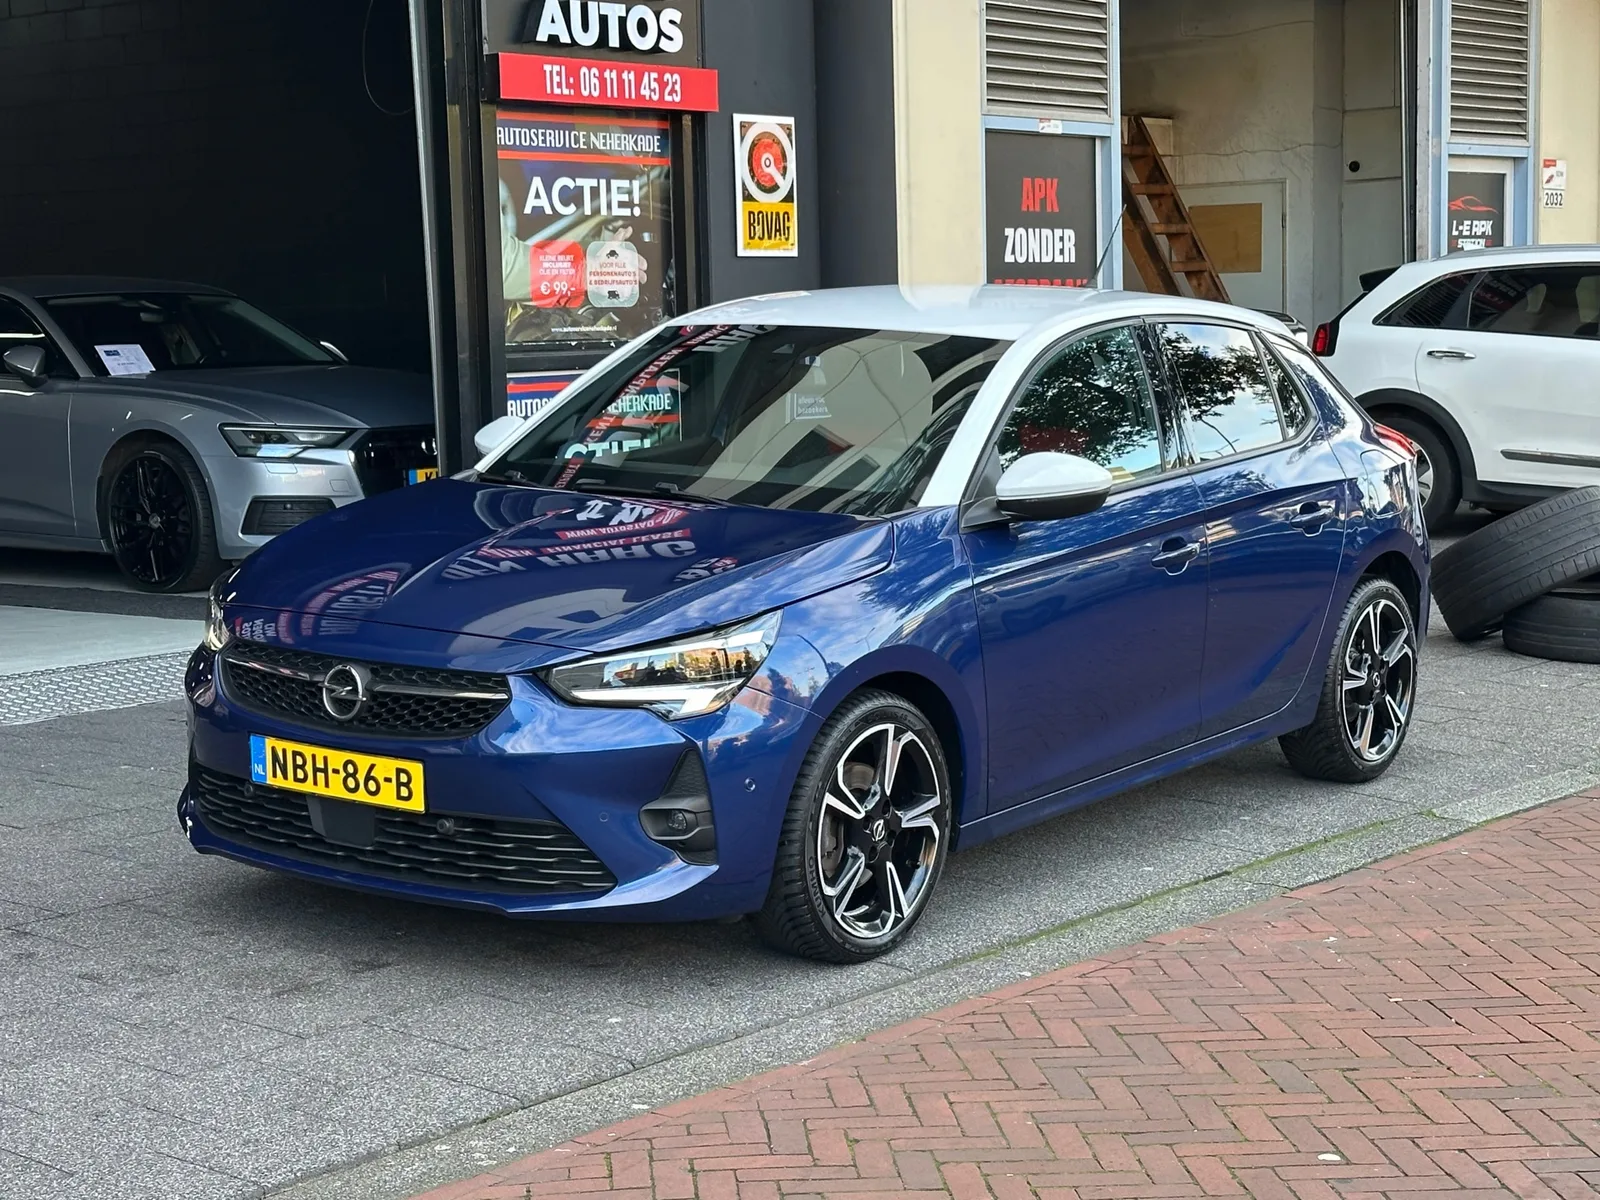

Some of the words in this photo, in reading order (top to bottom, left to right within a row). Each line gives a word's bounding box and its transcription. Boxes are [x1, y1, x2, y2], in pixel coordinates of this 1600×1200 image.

[535, 0, 684, 53] AUTOS
[543, 64, 575, 96] TEL:
[580, 66, 599, 98] 06
[604, 68, 618, 99] 11
[622, 69, 636, 99] 11
[640, 72, 659, 101] 45
[664, 72, 681, 102] 23
[496, 126, 587, 149] AUTOSERVICE
[590, 131, 661, 153] NEHERKADE
[523, 176, 641, 217] ACTIE!
[1021, 177, 1059, 213] APK
[1545, 192, 1563, 206] 2032
[748, 210, 790, 242] BOVAG
[1004, 227, 1076, 263] ZONDER
[553, 281, 576, 296] 99,-
[254, 763, 265, 775] NL
[270, 745, 413, 802] NBH-86-B
